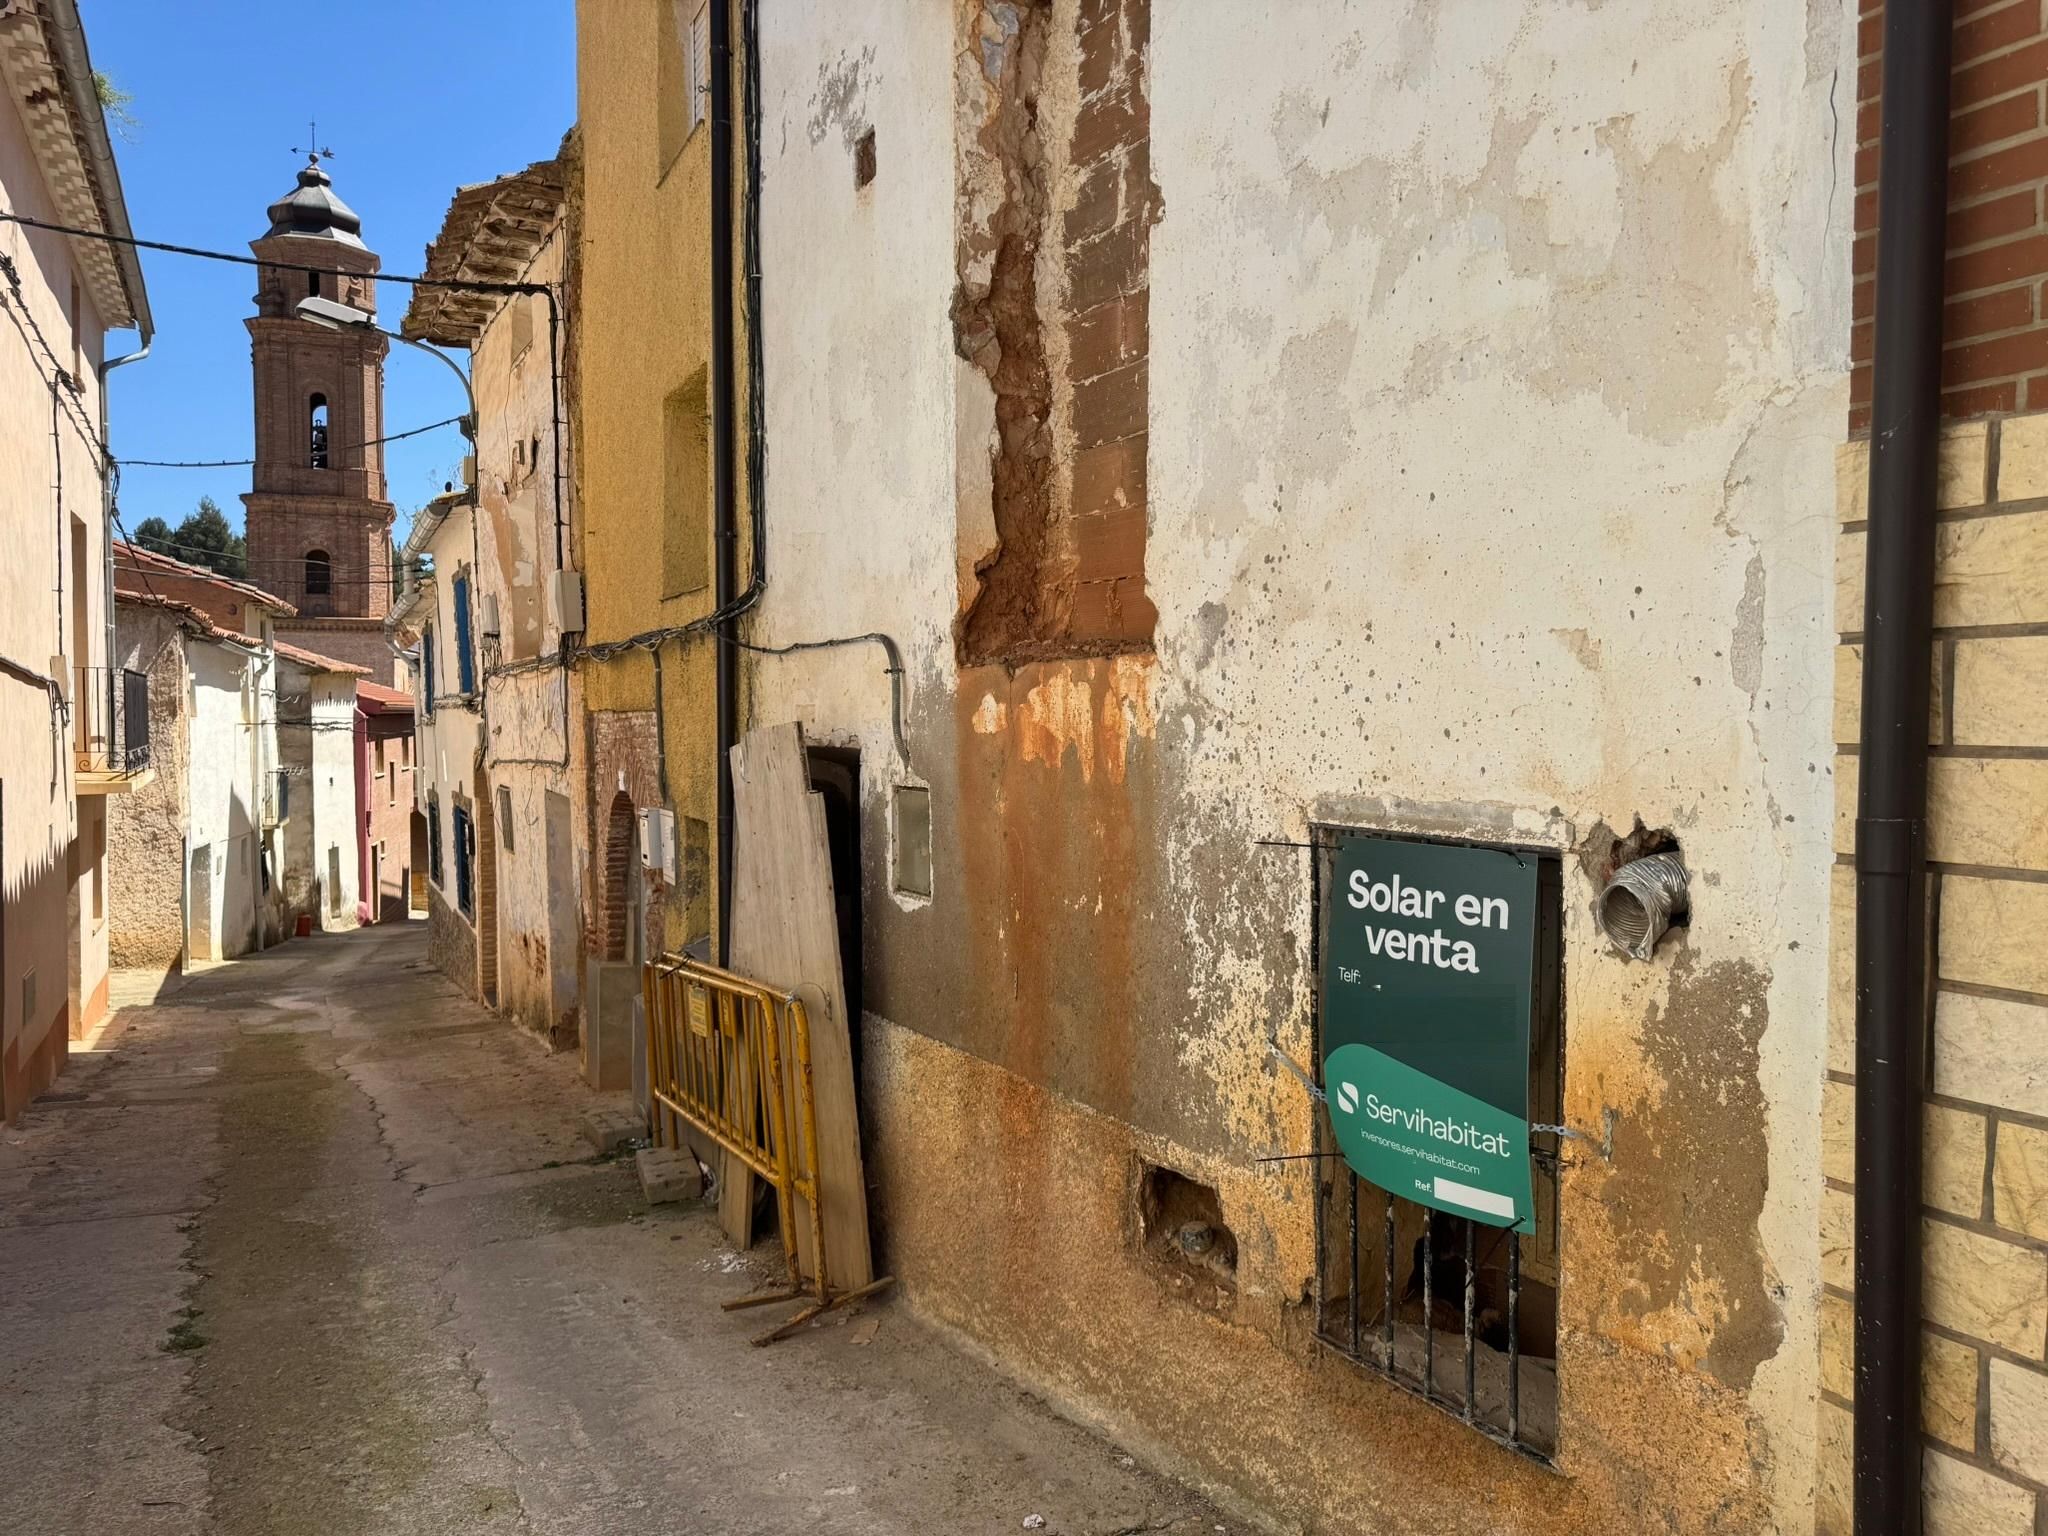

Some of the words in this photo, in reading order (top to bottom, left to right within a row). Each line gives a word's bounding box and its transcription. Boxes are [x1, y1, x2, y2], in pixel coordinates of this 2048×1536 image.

[1347, 869, 1446, 919] Solar
[1455, 894, 1509, 930] en
[1364, 925, 1480, 974] venta
[1337, 966, 1361, 985] Telf:
[1366, 1094, 1511, 1158] Servihabitat
[1360, 1128, 1480, 1175] inversores.servihabitat.com
[1415, 1179, 1432, 1193] Ref.
